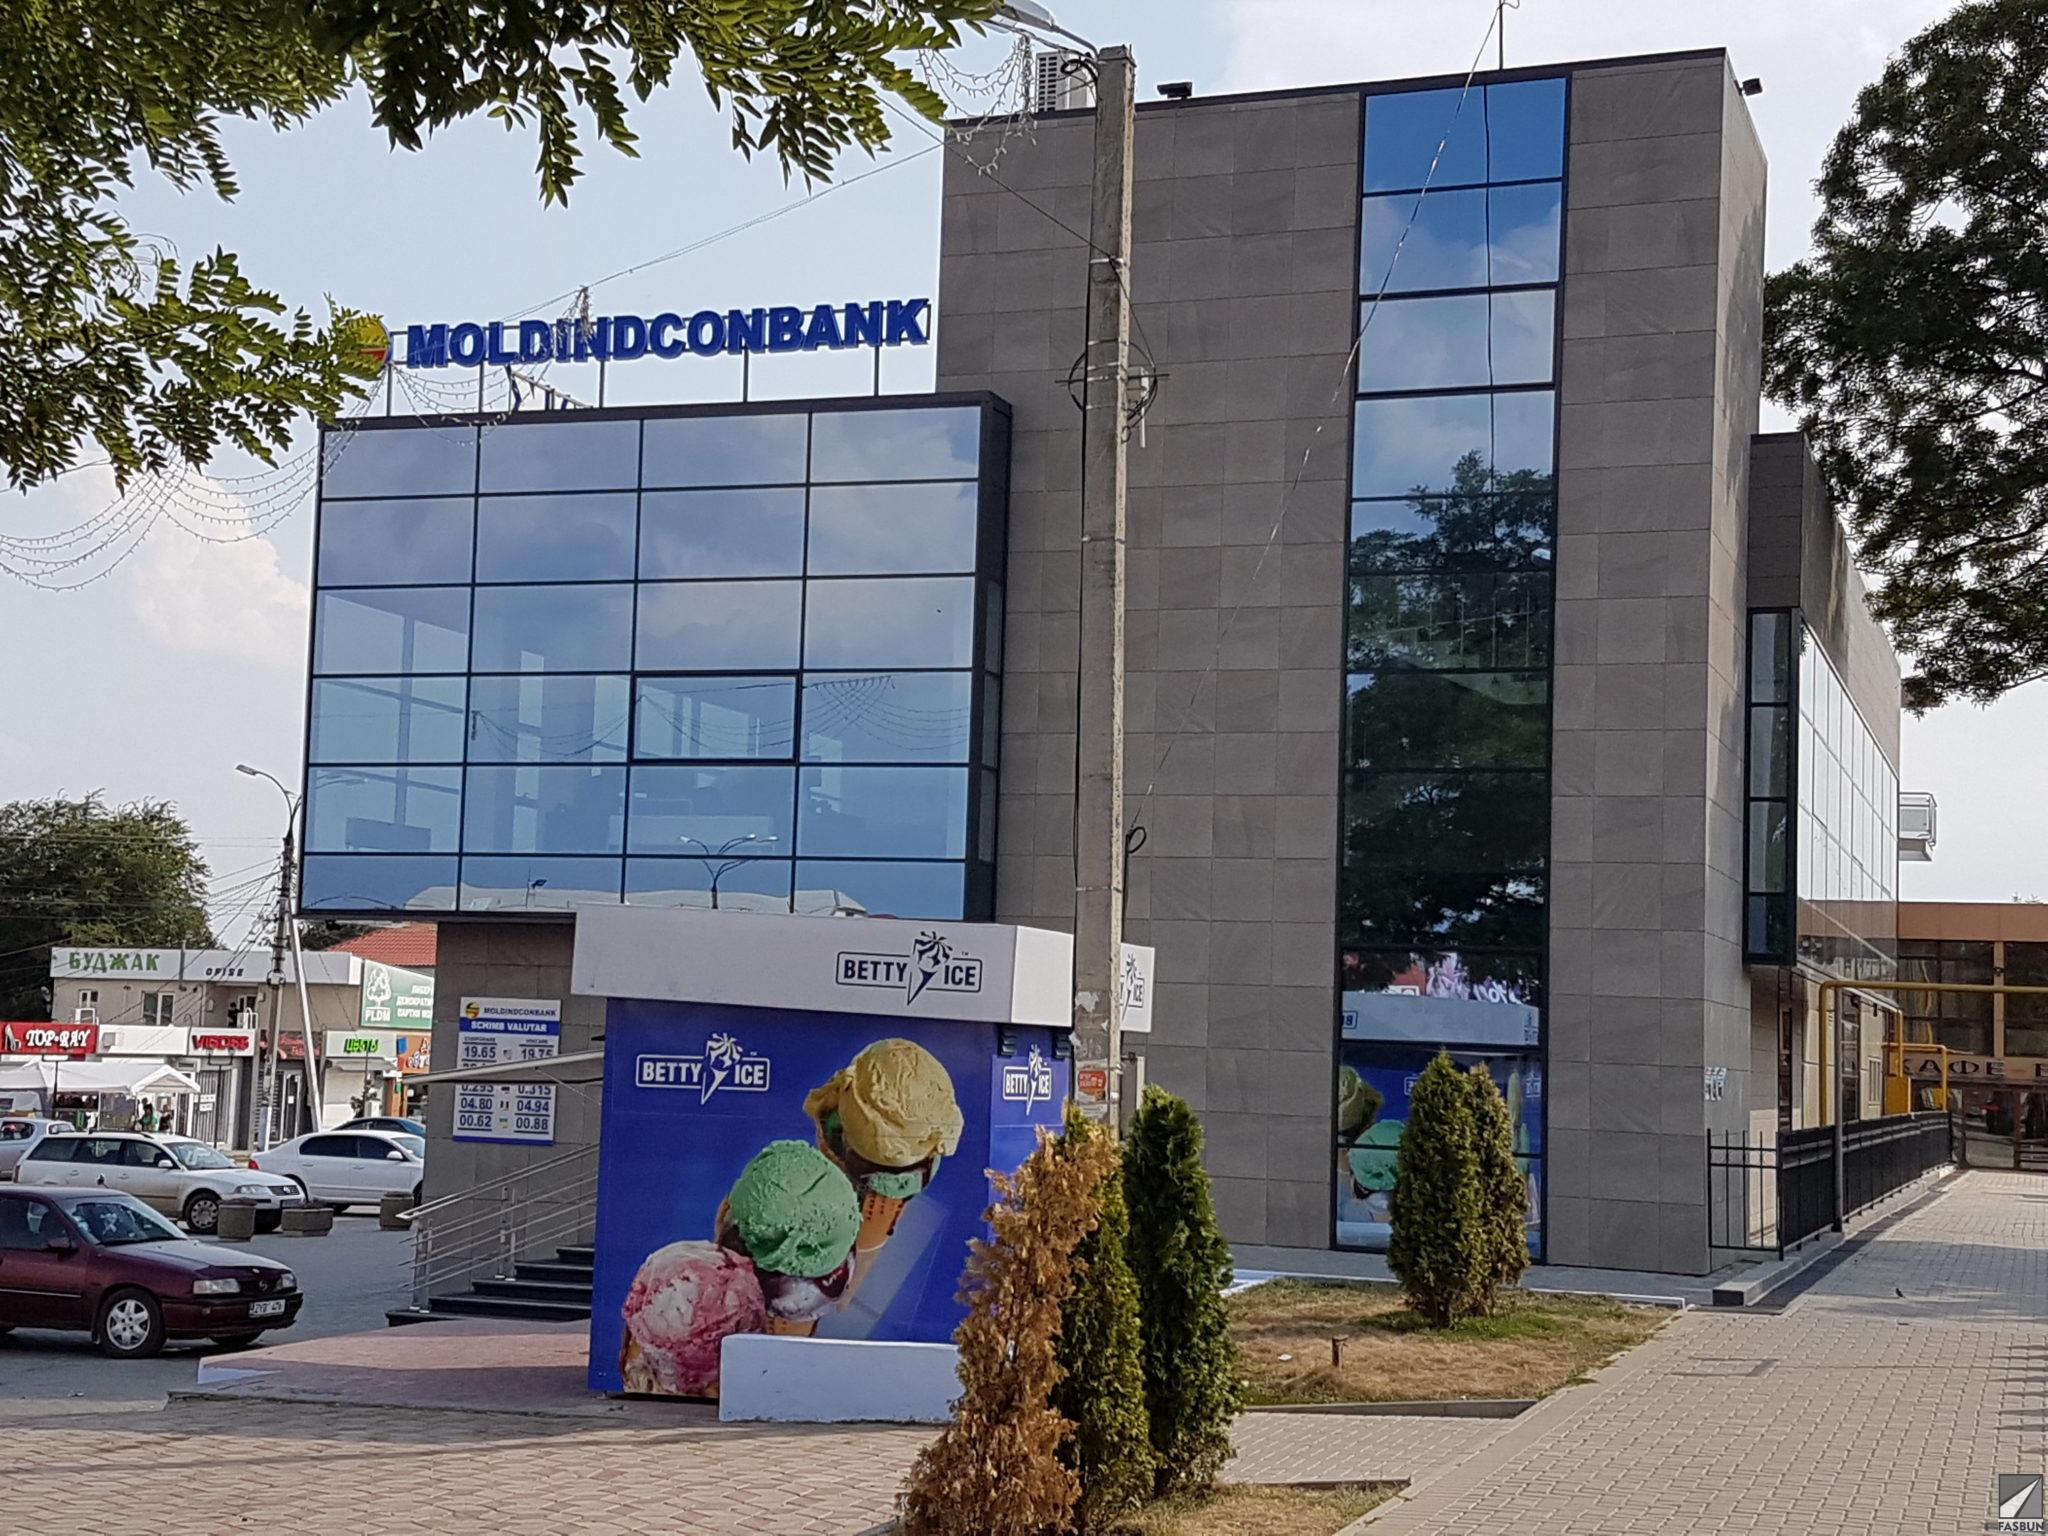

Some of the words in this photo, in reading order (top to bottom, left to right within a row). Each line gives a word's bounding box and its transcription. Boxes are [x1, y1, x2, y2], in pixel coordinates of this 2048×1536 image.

[407, 298, 930, 368] MOLDINDCONBANK
[69, 952, 160, 973] БУДЖАК
[844, 960, 909, 983] BETTY
[944, 964, 976, 986] ICE
[1133, 984, 1143, 1002] ICE
[365, 1009, 391, 1022] PLDM
[484, 1007, 556, 1017] MOLDINDCONBANK
[471, 1021, 505, 1031] SCHIMB
[507, 1023, 548, 1033] VALUTAR
[464, 1046, 496, 1059] 19.65
[642, 1061, 702, 1083] BETTY
[734, 1064, 764, 1086] ICE
[1005, 1073, 1027, 1093] BETTY
[1038, 1074, 1050, 1093] ICE
[460, 1098, 493, 1110] 04.80
[517, 1100, 549, 1113] 04.94
[459, 1115, 492, 1127] 00.62
[516, 1118, 548, 1130] 00.88
